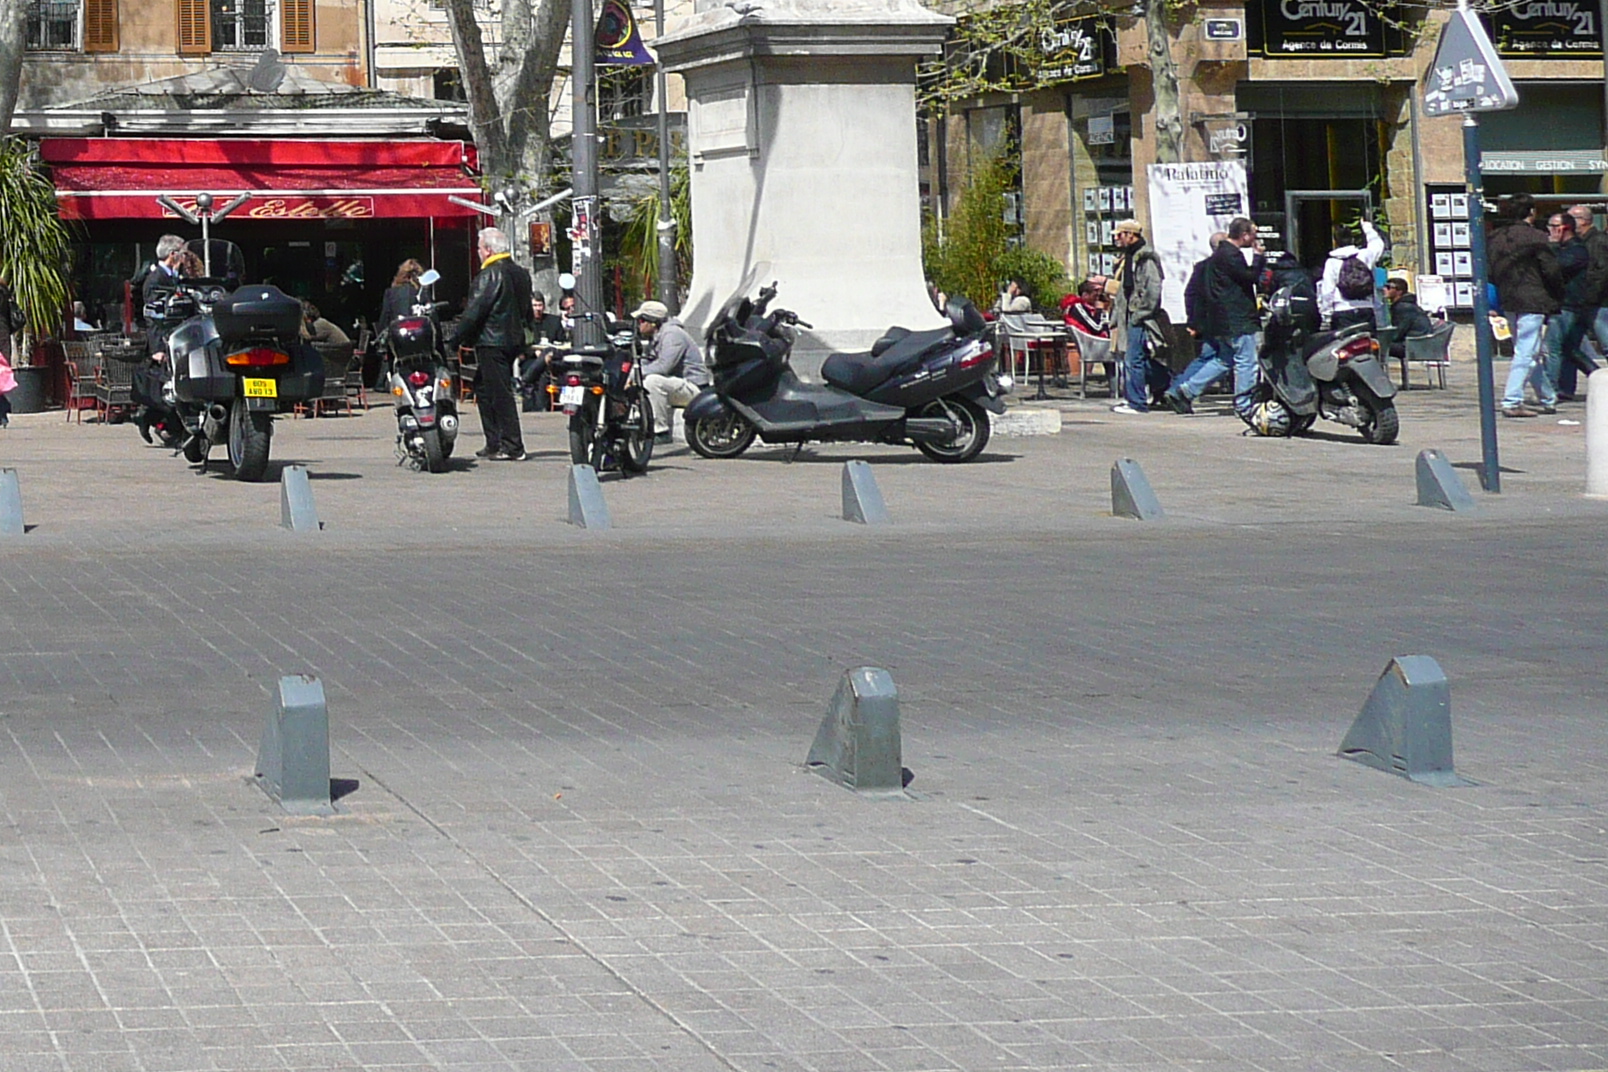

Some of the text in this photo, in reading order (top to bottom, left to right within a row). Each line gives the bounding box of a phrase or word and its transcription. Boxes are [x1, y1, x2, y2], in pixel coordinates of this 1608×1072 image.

[1344, 11, 1367, 36] 21
[1572, 11, 1595, 36] 21
[1282, 39, 1317, 52] Agence
[1320, 39, 1333, 50] de
[1511, 39, 1549, 51] Agence
[1485, 160, 1525, 170] LOCATION
[1535, 160, 1575, 170] GESTION
[249, 199, 372, 218] Estelle
